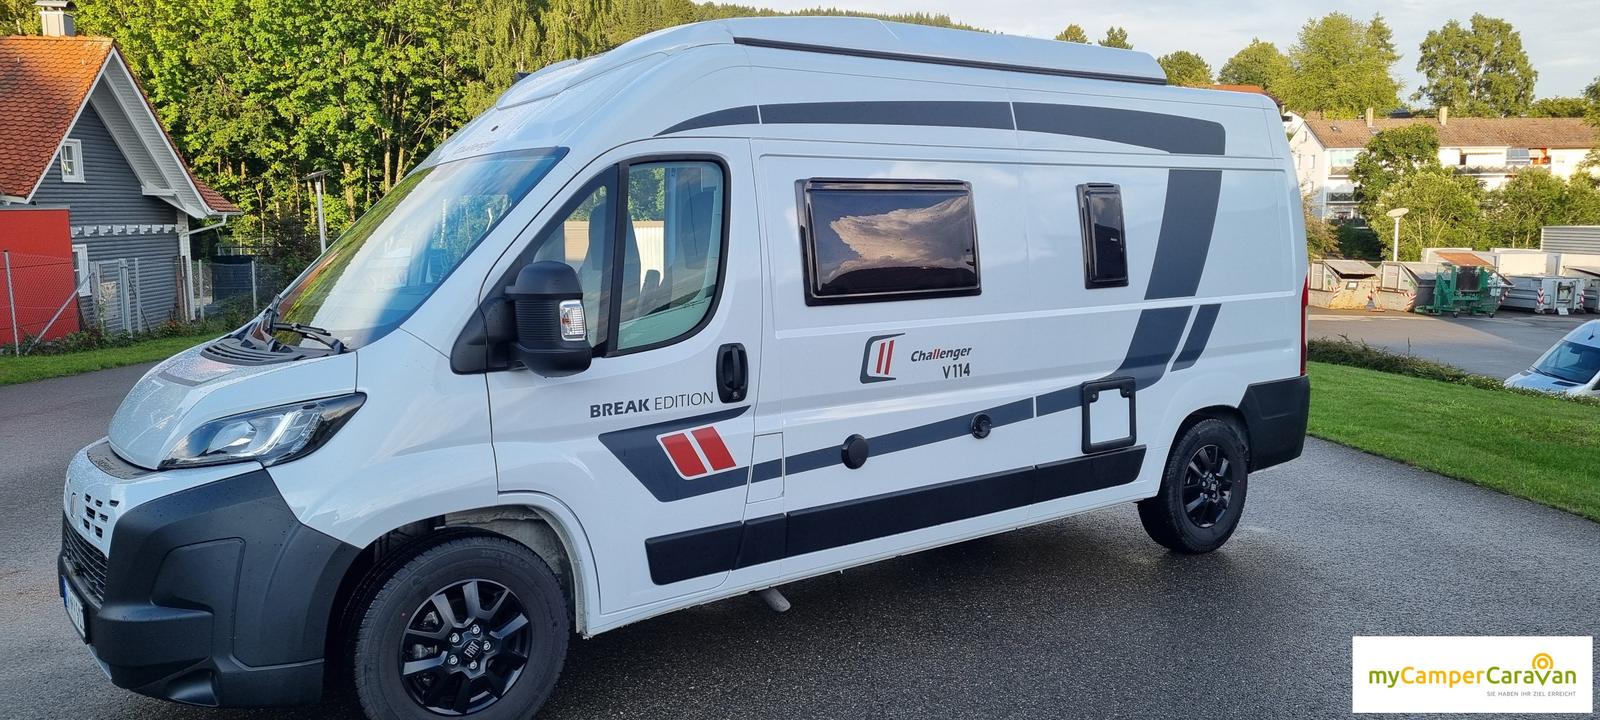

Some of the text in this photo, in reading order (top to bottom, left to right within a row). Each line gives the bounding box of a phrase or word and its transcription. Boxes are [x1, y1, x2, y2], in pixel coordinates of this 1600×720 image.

[910, 347, 972, 362] Challenger
[590, 391, 714, 418] BREAK EDITION
[463, 641, 480, 658] FIAT
